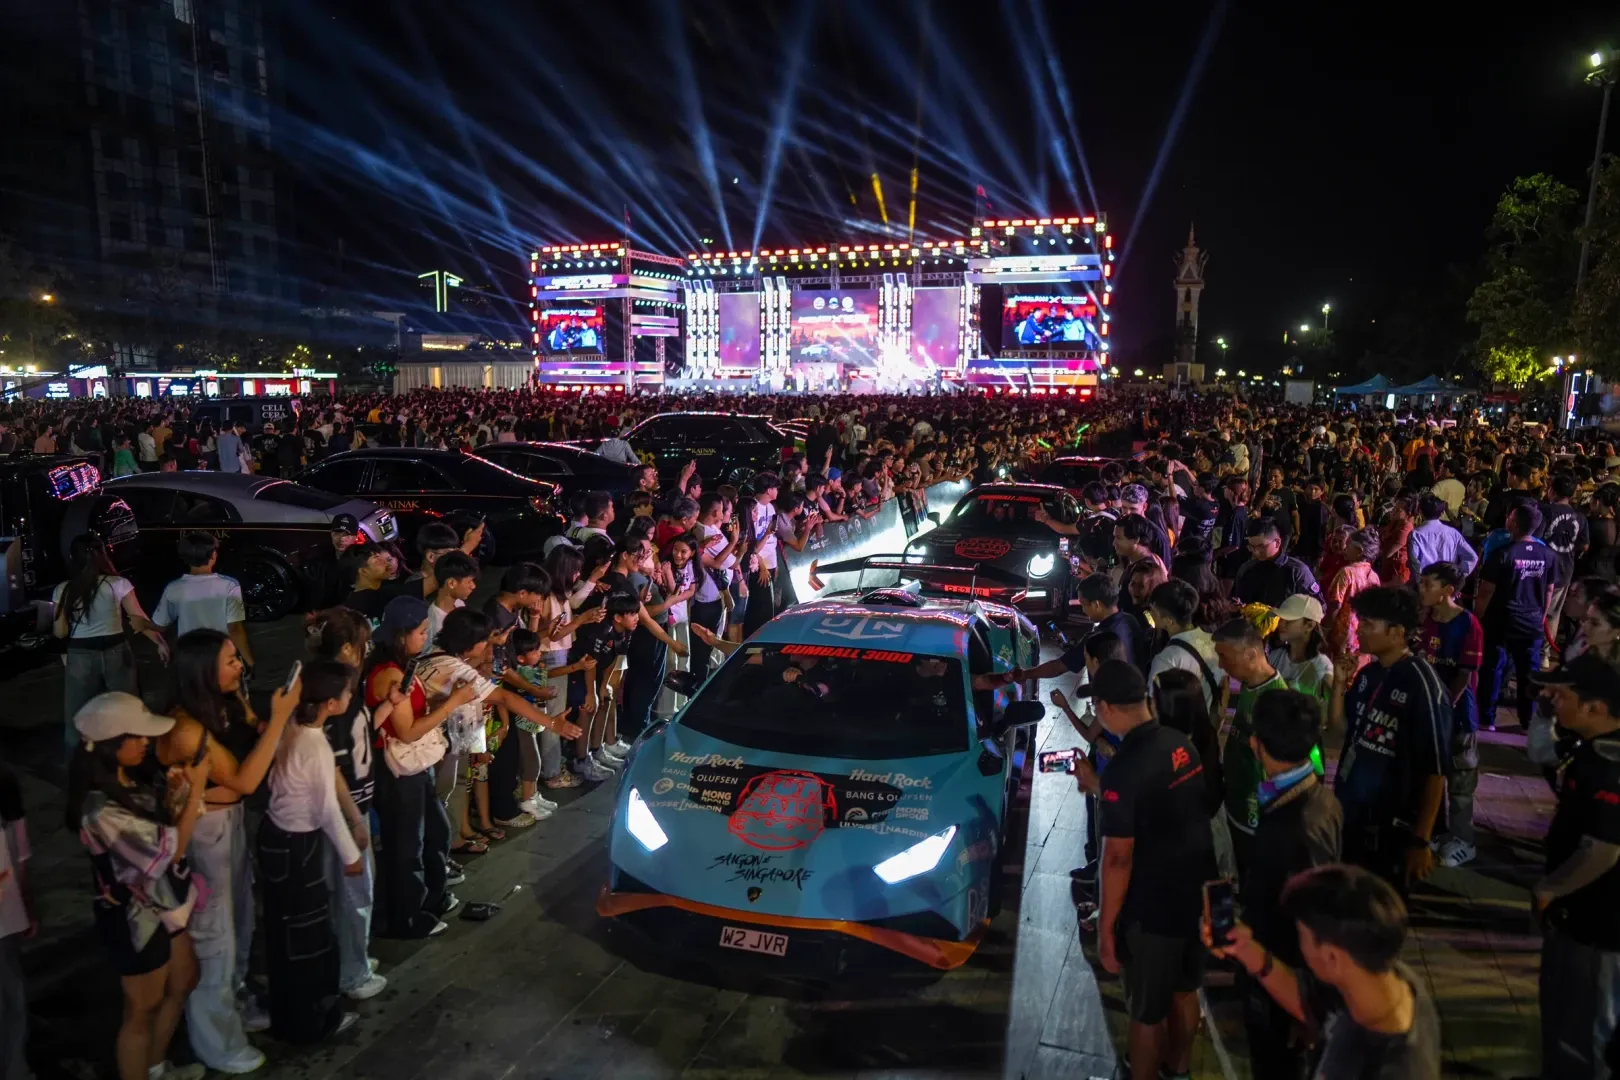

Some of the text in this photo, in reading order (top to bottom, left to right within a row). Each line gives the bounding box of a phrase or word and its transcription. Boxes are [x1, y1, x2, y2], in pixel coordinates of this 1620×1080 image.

[780, 644, 913, 664] GUMBALL 3000
[668, 751, 744, 770] Hard Rock
[661, 767, 686, 777] BANG
[696, 774, 739, 785] OLUFSEN
[849, 769, 933, 789] Hard Rock
[676, 782, 732, 800] CHIP MONG
[845, 790, 933, 802] BANG & OLUFSEN
[886, 825, 928, 839] NARDIN
[707, 852, 763, 870] SAIGON
[725, 867, 815, 891] SINGAPORE
[722, 927, 787, 953] W2 JVR
